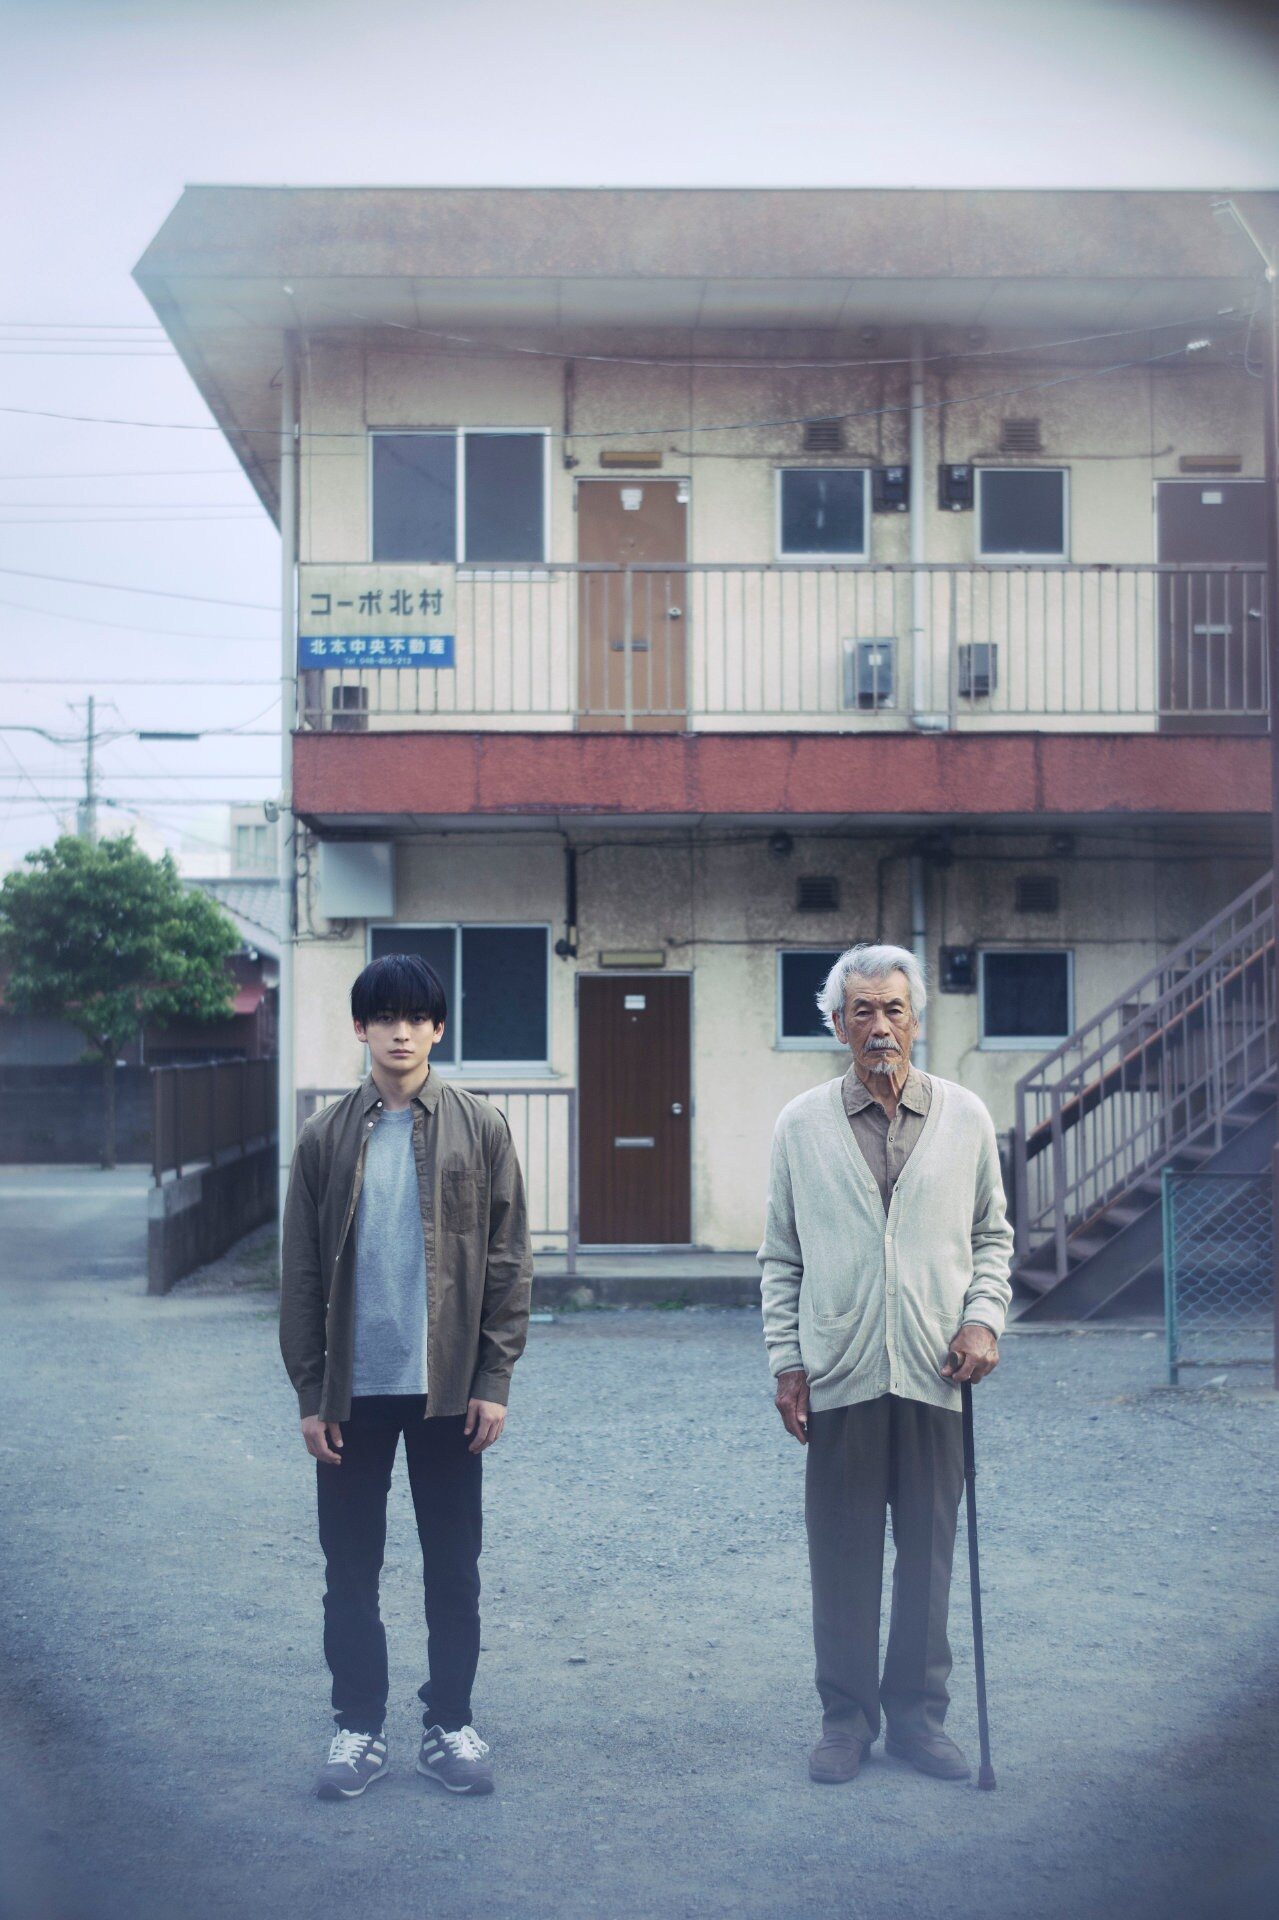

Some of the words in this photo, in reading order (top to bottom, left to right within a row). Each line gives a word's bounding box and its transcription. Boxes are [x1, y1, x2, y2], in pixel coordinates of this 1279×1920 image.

[311, 589, 443, 616] コーポ北村
[310, 639, 445, 655] 北本中央不動産
